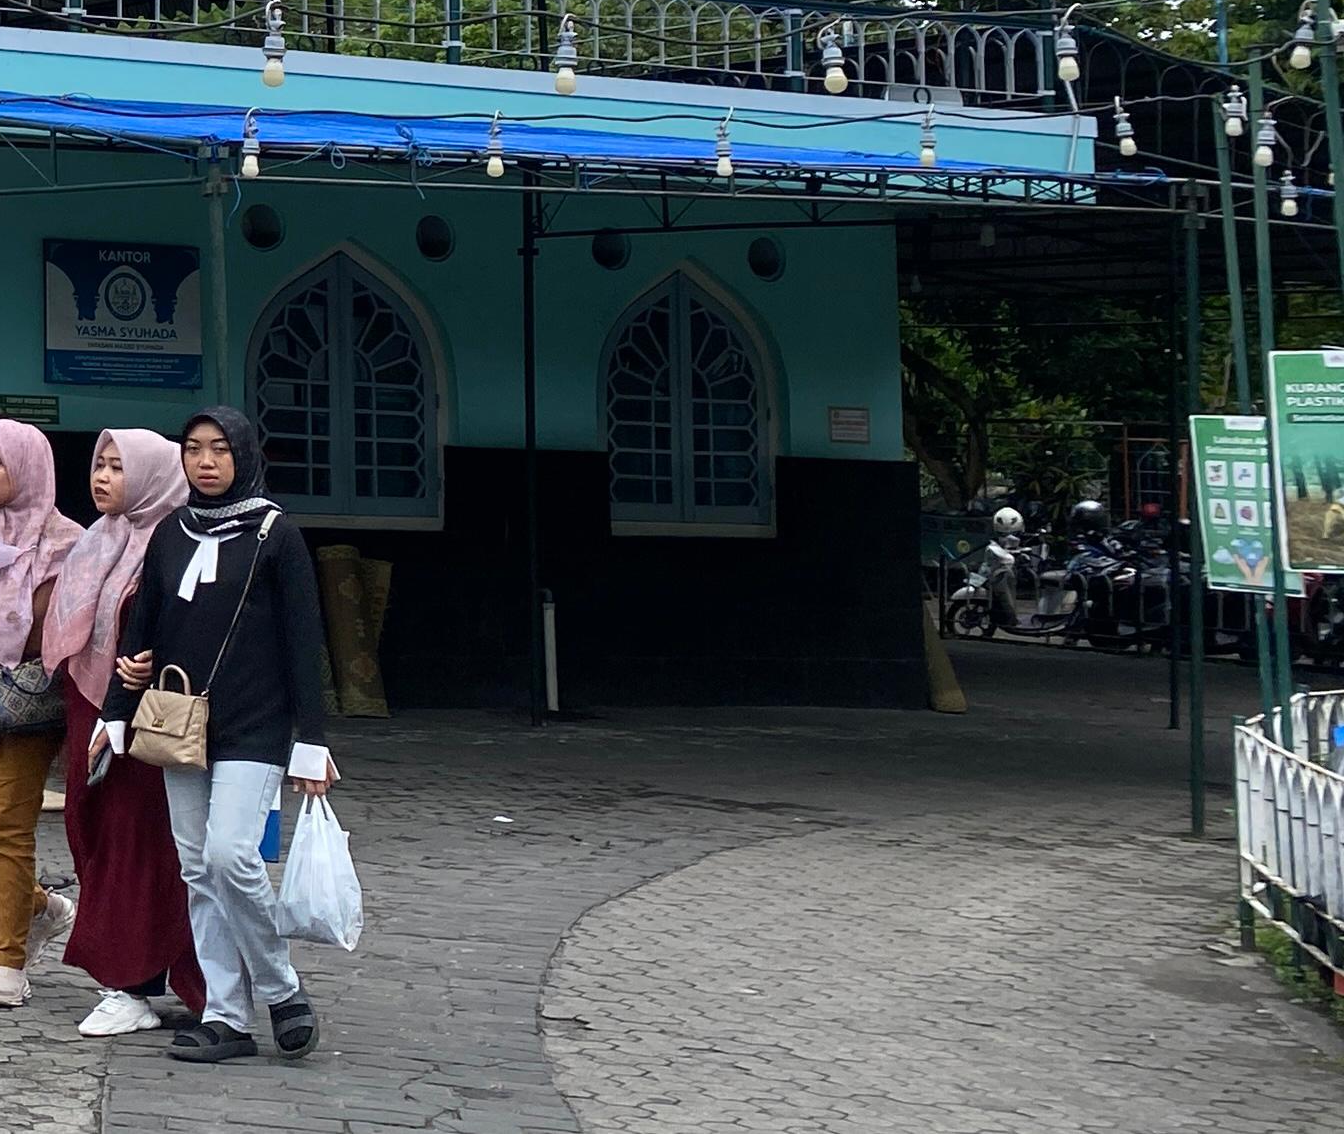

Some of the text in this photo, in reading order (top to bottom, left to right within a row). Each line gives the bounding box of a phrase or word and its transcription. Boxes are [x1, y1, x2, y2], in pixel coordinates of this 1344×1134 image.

[98, 249, 151, 263] KANTOR
[75, 325, 178, 339] YASMA SYUHADA
